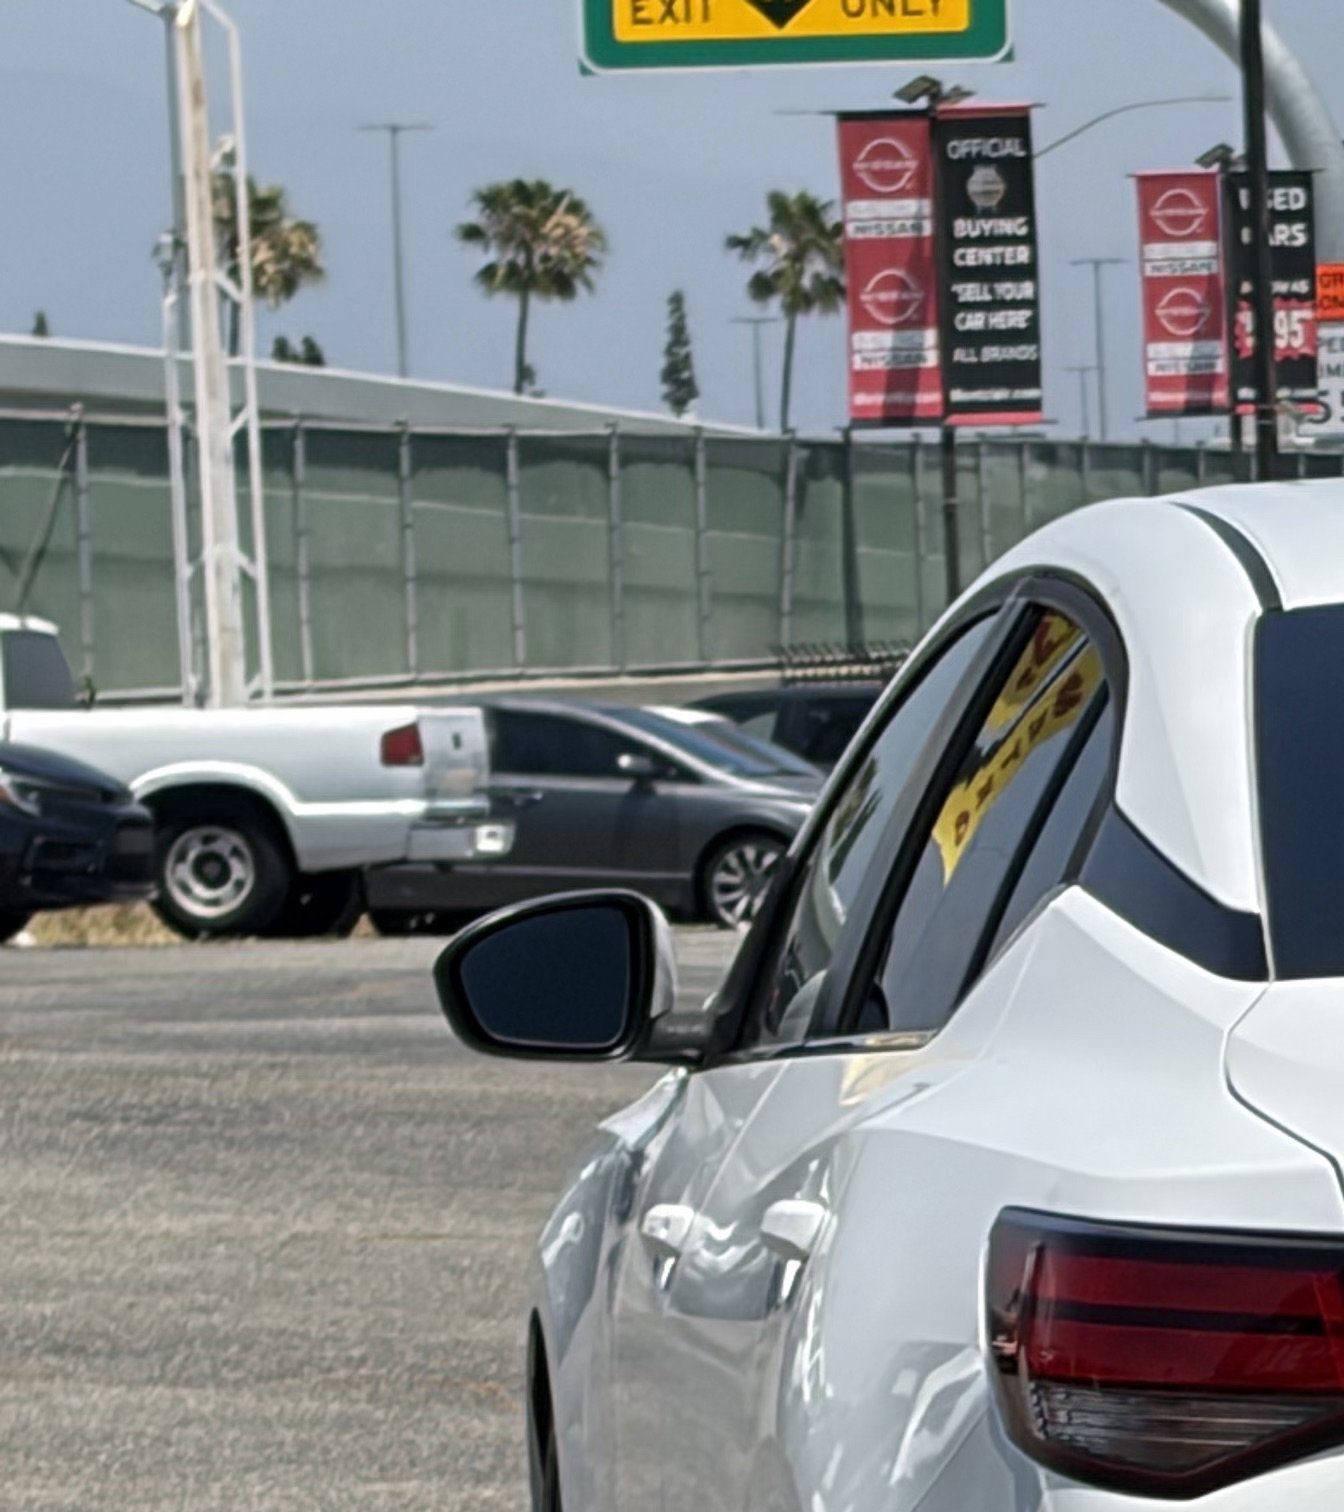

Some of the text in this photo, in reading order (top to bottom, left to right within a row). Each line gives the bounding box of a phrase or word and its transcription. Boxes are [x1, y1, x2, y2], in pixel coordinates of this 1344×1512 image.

[947, 138, 1027, 159] OFFICIAL
[953, 216, 1030, 238] BUYING
[953, 246, 1031, 267] CENTER
[954, 312, 985, 332] CAR
